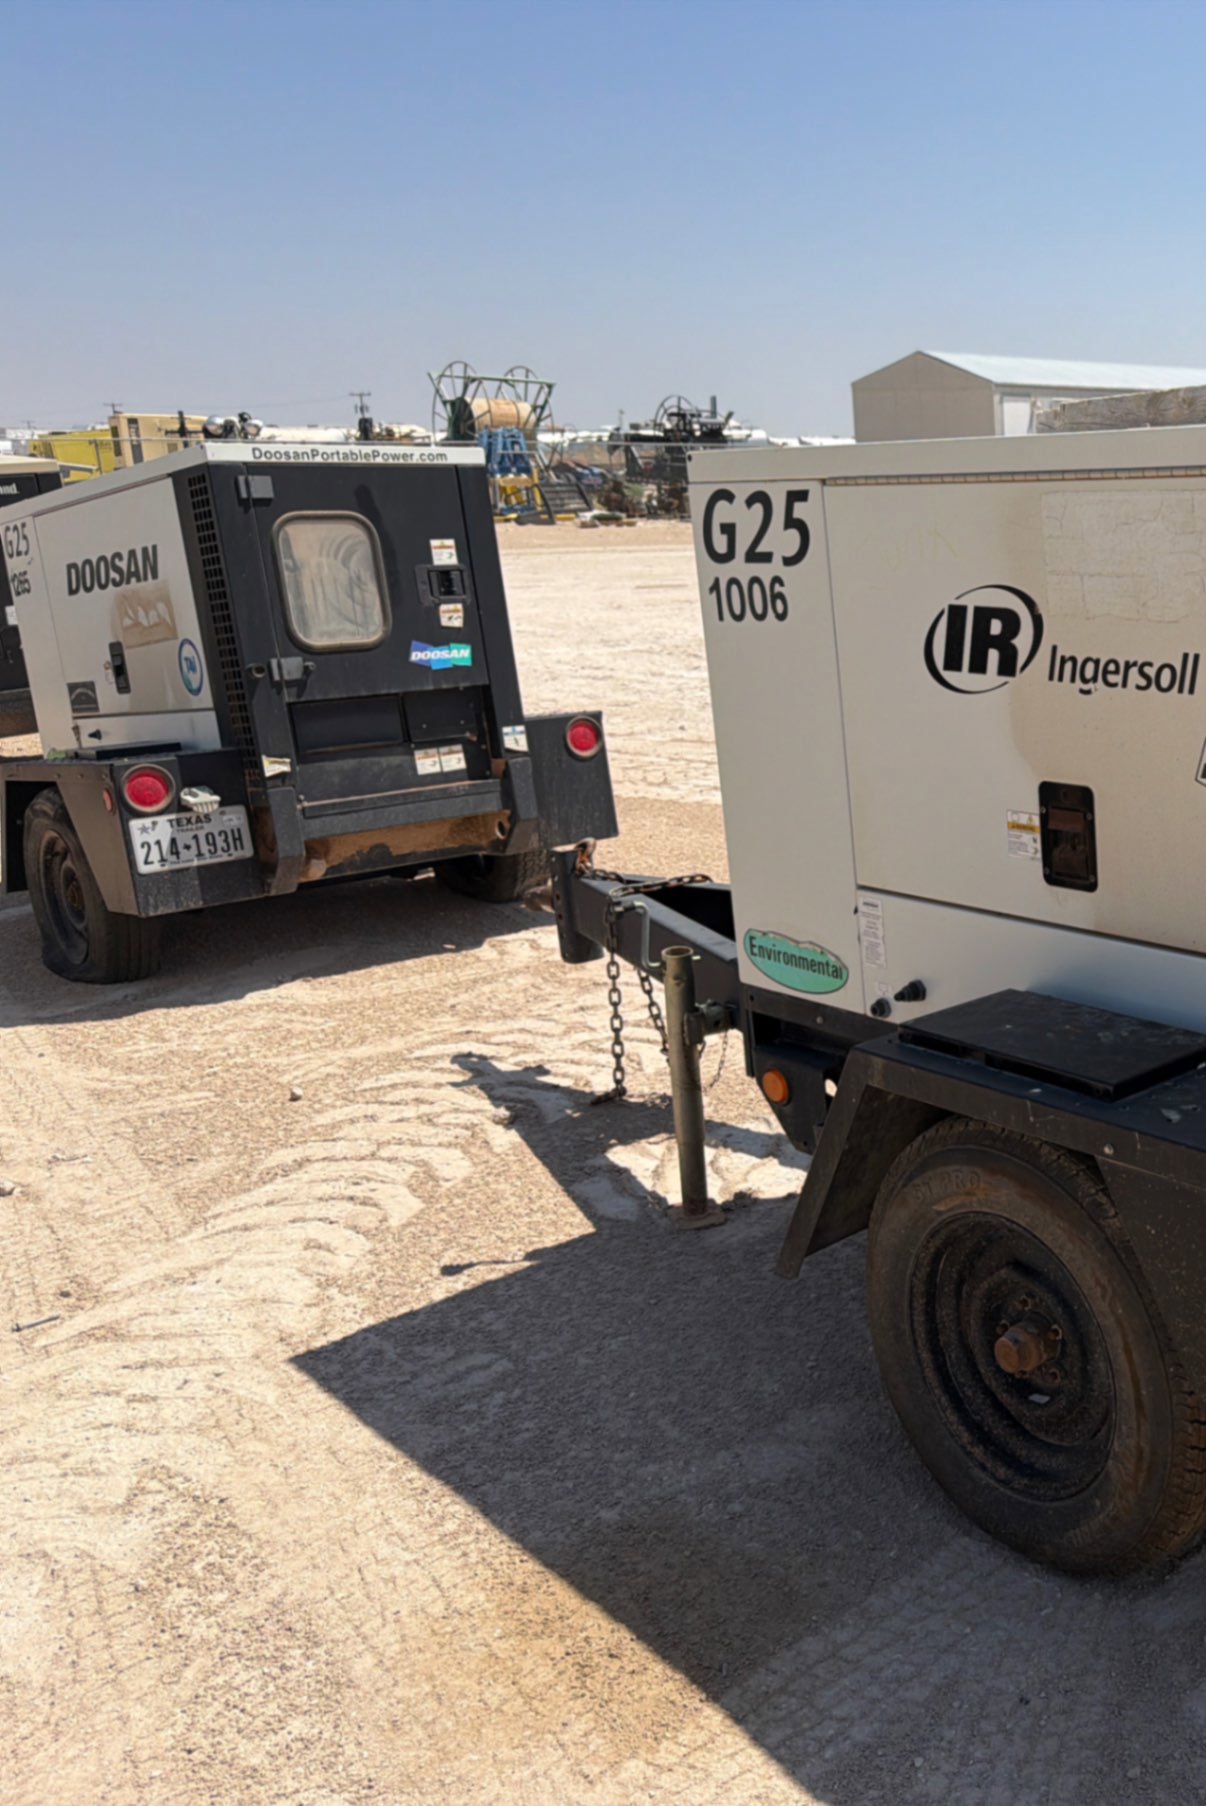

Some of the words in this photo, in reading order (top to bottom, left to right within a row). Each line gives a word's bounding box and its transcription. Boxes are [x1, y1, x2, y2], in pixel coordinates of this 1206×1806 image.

[252, 447, 448, 462] DoosanPortablePower.com
[4, 522, 30, 559] G25
[702, 488, 810, 567] G25
[66, 544, 159, 596] DOOSAN
[709, 575, 788, 622] 1006
[410, 648, 471, 662] DOOSAN
[943, 604, 1022, 678] IR
[1048, 645, 1200, 696] Ingersoll
[166, 814, 212, 829] TEXAS
[749, 936, 843, 980] Environmental
